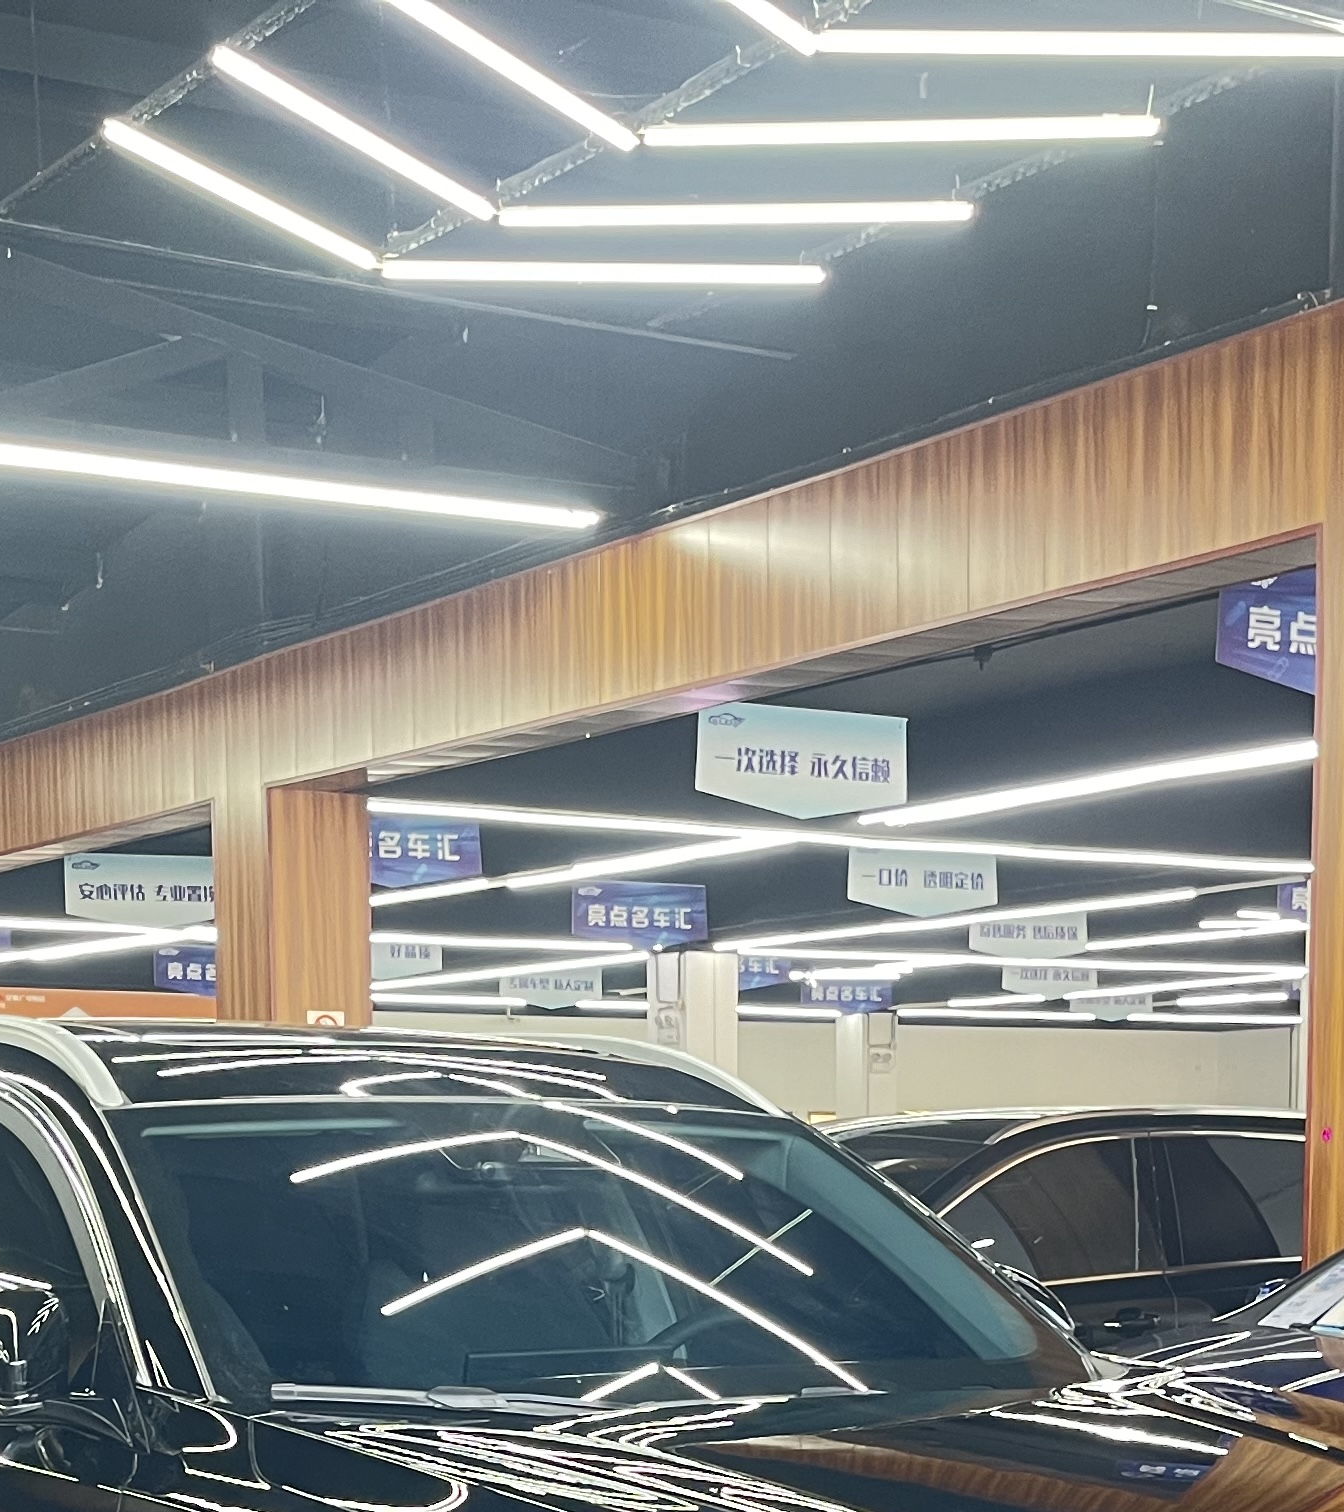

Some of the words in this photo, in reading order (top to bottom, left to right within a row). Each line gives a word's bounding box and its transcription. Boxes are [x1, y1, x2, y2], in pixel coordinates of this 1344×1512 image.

[714, 746, 800, 777] 一次选择
[810, 752, 892, 784] 永久信赖
[368, 830, 461, 861] 名车汇
[78, 883, 146, 901] 安心评估
[862, 868, 908, 887] 一口价
[923, 870, 984, 891] 透明定价
[586, 904, 693, 930] 亮点名车汇
